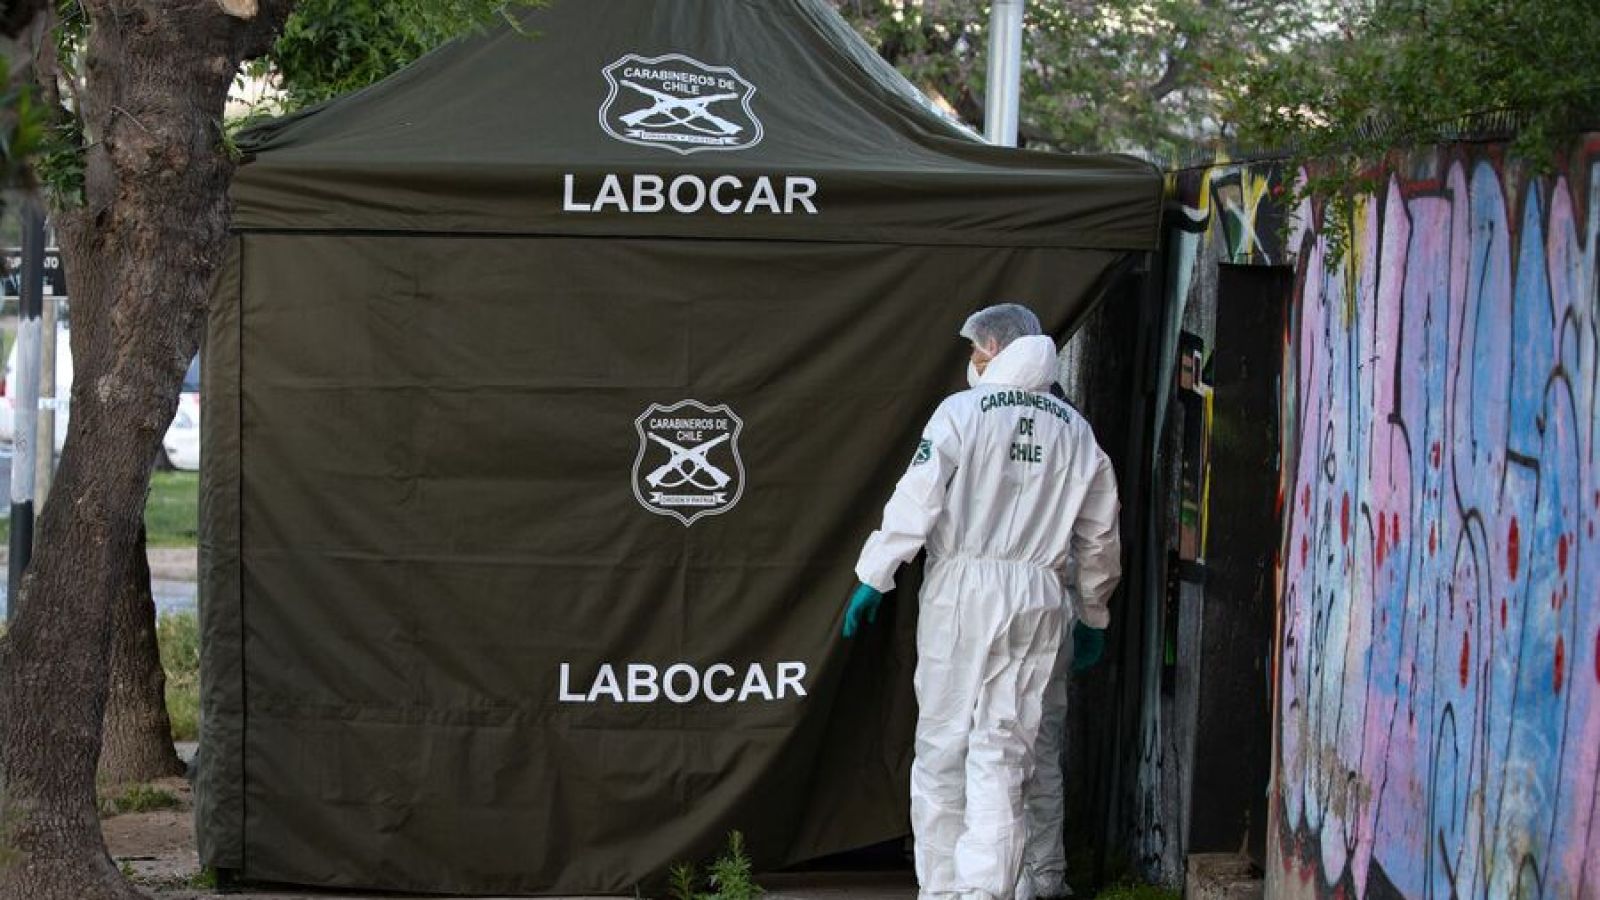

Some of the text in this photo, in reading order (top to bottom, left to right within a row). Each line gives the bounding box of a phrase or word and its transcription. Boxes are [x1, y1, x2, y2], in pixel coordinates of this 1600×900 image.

[623, 67, 736, 91] CARABINEROS DE
[662, 80, 700, 95] CHILE
[563, 174, 818, 214] LABOCAR
[981, 390, 1070, 424] CARABINEROS
[650, 418, 728, 430] CARABINEROS DE
[1019, 416, 1034, 437] DE
[677, 430, 703, 441] CHILE
[1009, 441, 1042, 463] CHILE
[559, 661, 808, 703] LABOCAR
